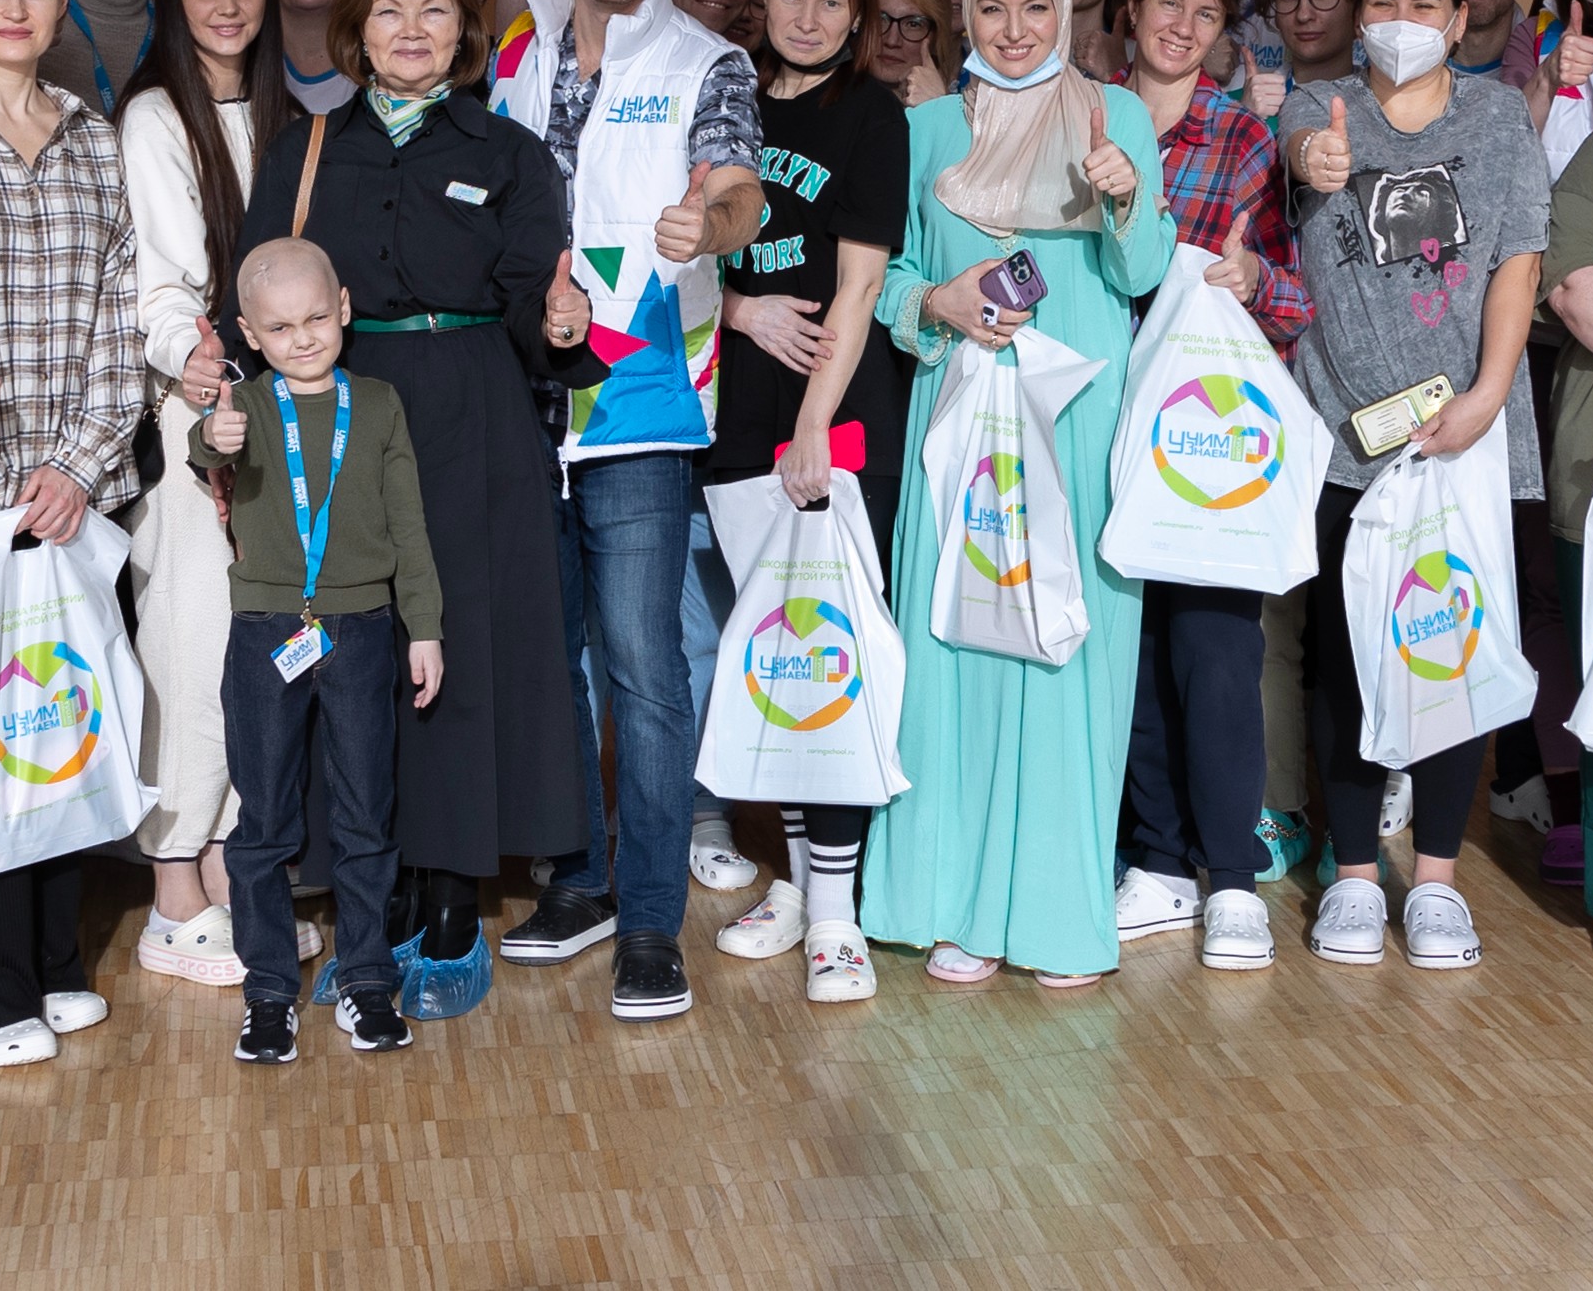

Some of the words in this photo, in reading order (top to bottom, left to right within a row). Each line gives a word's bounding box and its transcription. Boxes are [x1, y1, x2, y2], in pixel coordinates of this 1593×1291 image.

[606, 95, 669, 123] УЧИМ
[622, 107, 667, 123] ЗНАЕМ
[750, 234, 805, 273] YORK
[1167, 334, 1204, 344] ШКОЛА
[1207, 335, 1220, 344] НА
[1183, 345, 1241, 360] ВЫТЯНУТОЙ
[1168, 430, 1230, 454] УЧИМ
[1185, 441, 1229, 458] ЗНАЕМ
[1406, 606, 1455, 645] УЧИМ
[1420, 619, 1458, 641] ЗНАЕМ
[2, 703, 59, 741] УЧИМ
[19, 718, 61, 738] ЗНАЕМ
[178, 958, 237, 977] crocs
